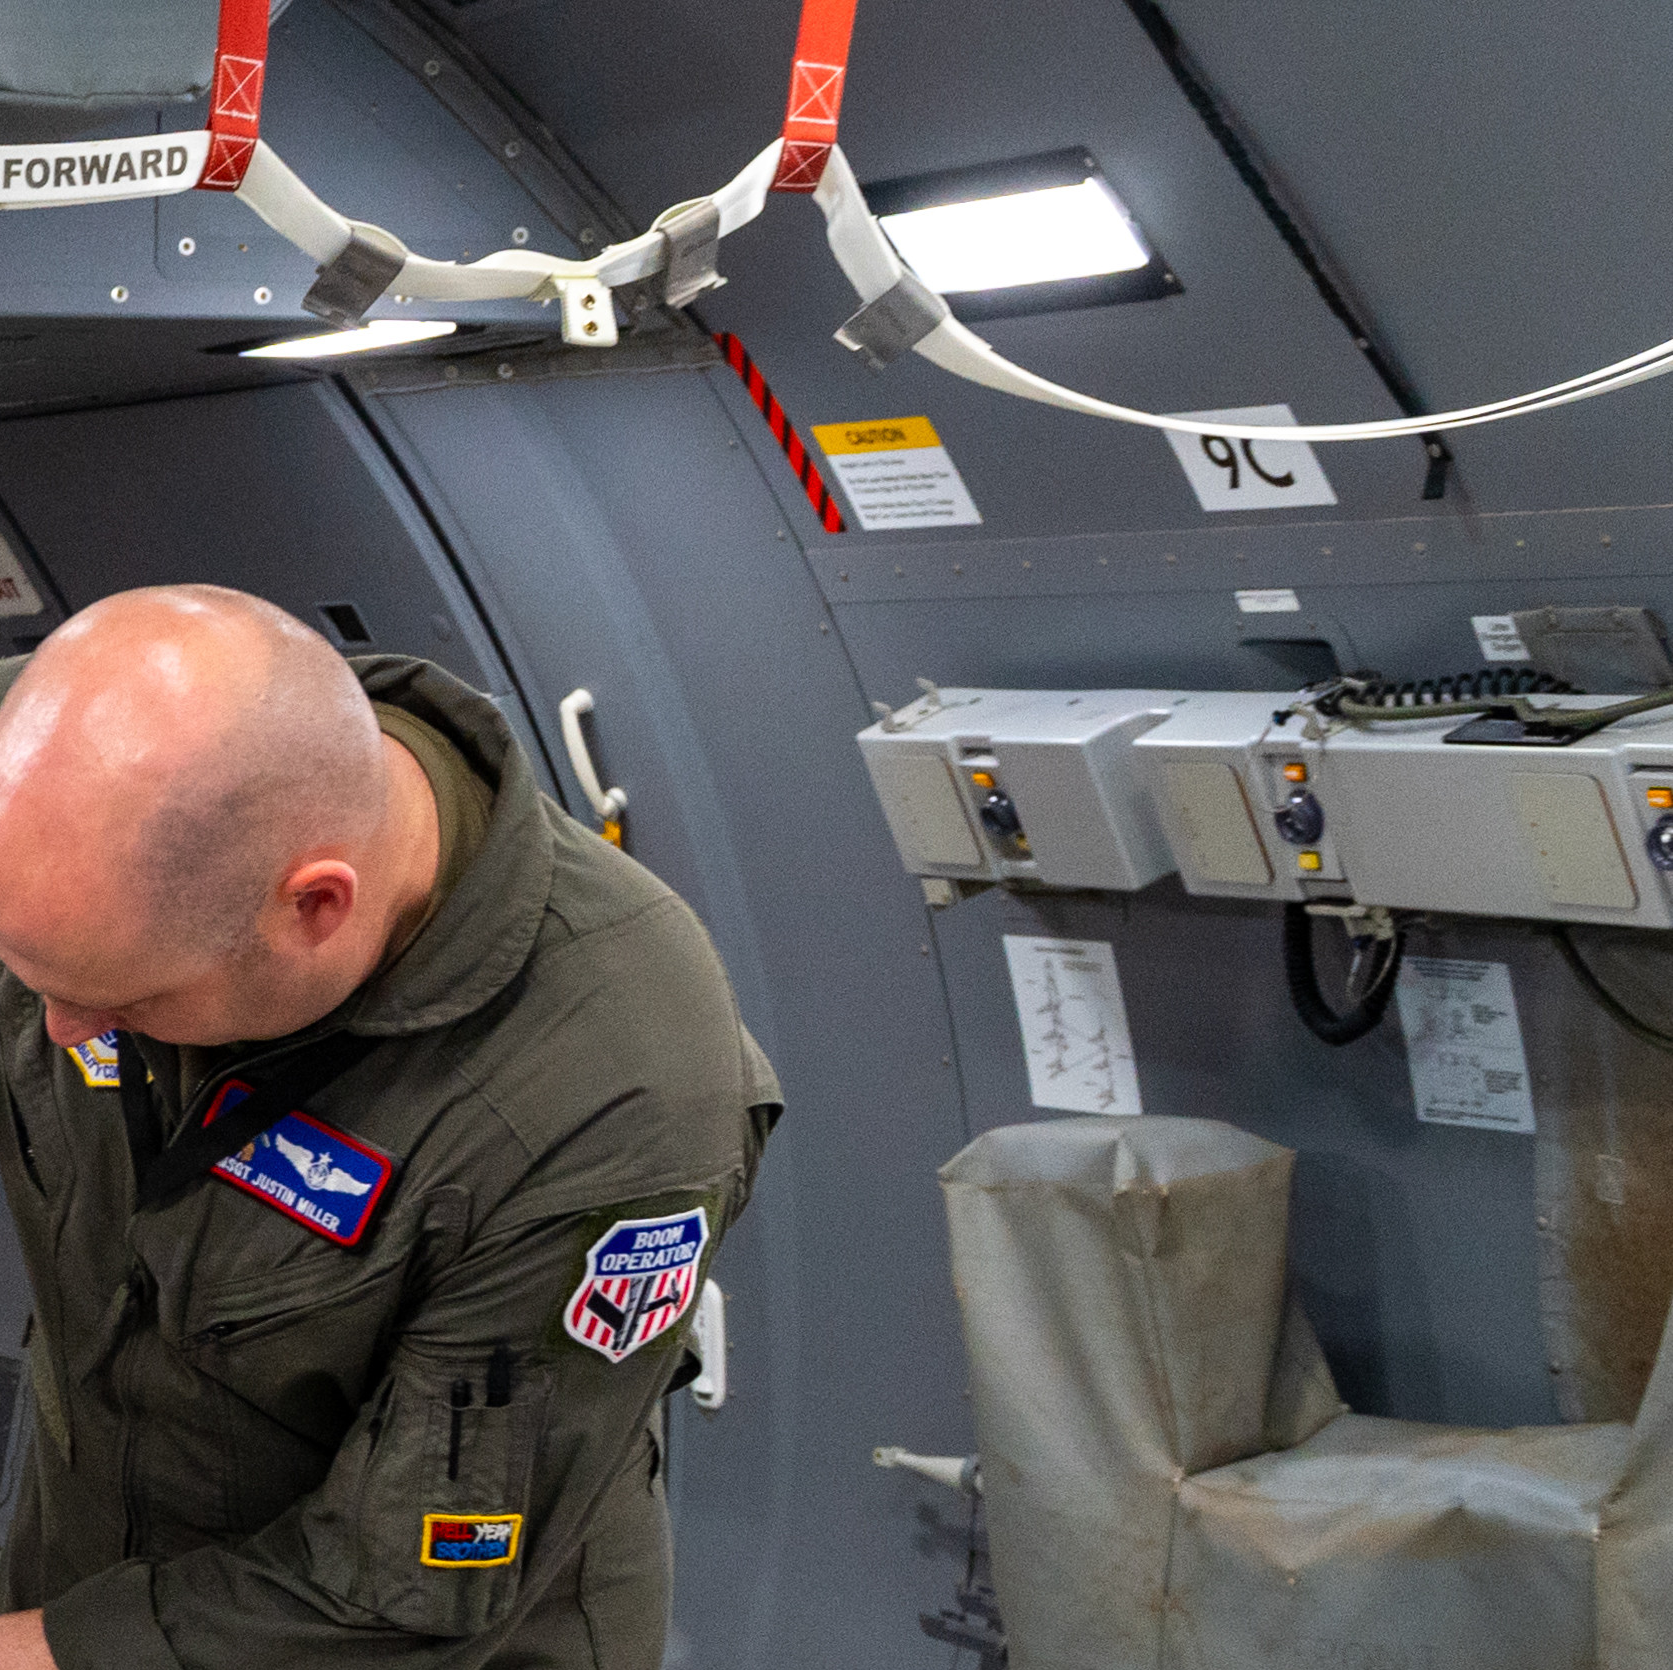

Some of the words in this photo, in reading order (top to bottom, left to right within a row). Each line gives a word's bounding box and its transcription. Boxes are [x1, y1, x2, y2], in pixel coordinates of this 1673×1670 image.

[3, 145, 188, 189] FORWARD
[251, 1172, 298, 1207] JUSTIN
[295, 1196, 341, 1233] MILLER
[632, 1224, 685, 1250] BOOM
[600, 1241, 697, 1272] OPERATOR
[473, 1522, 513, 1545] YEAH
